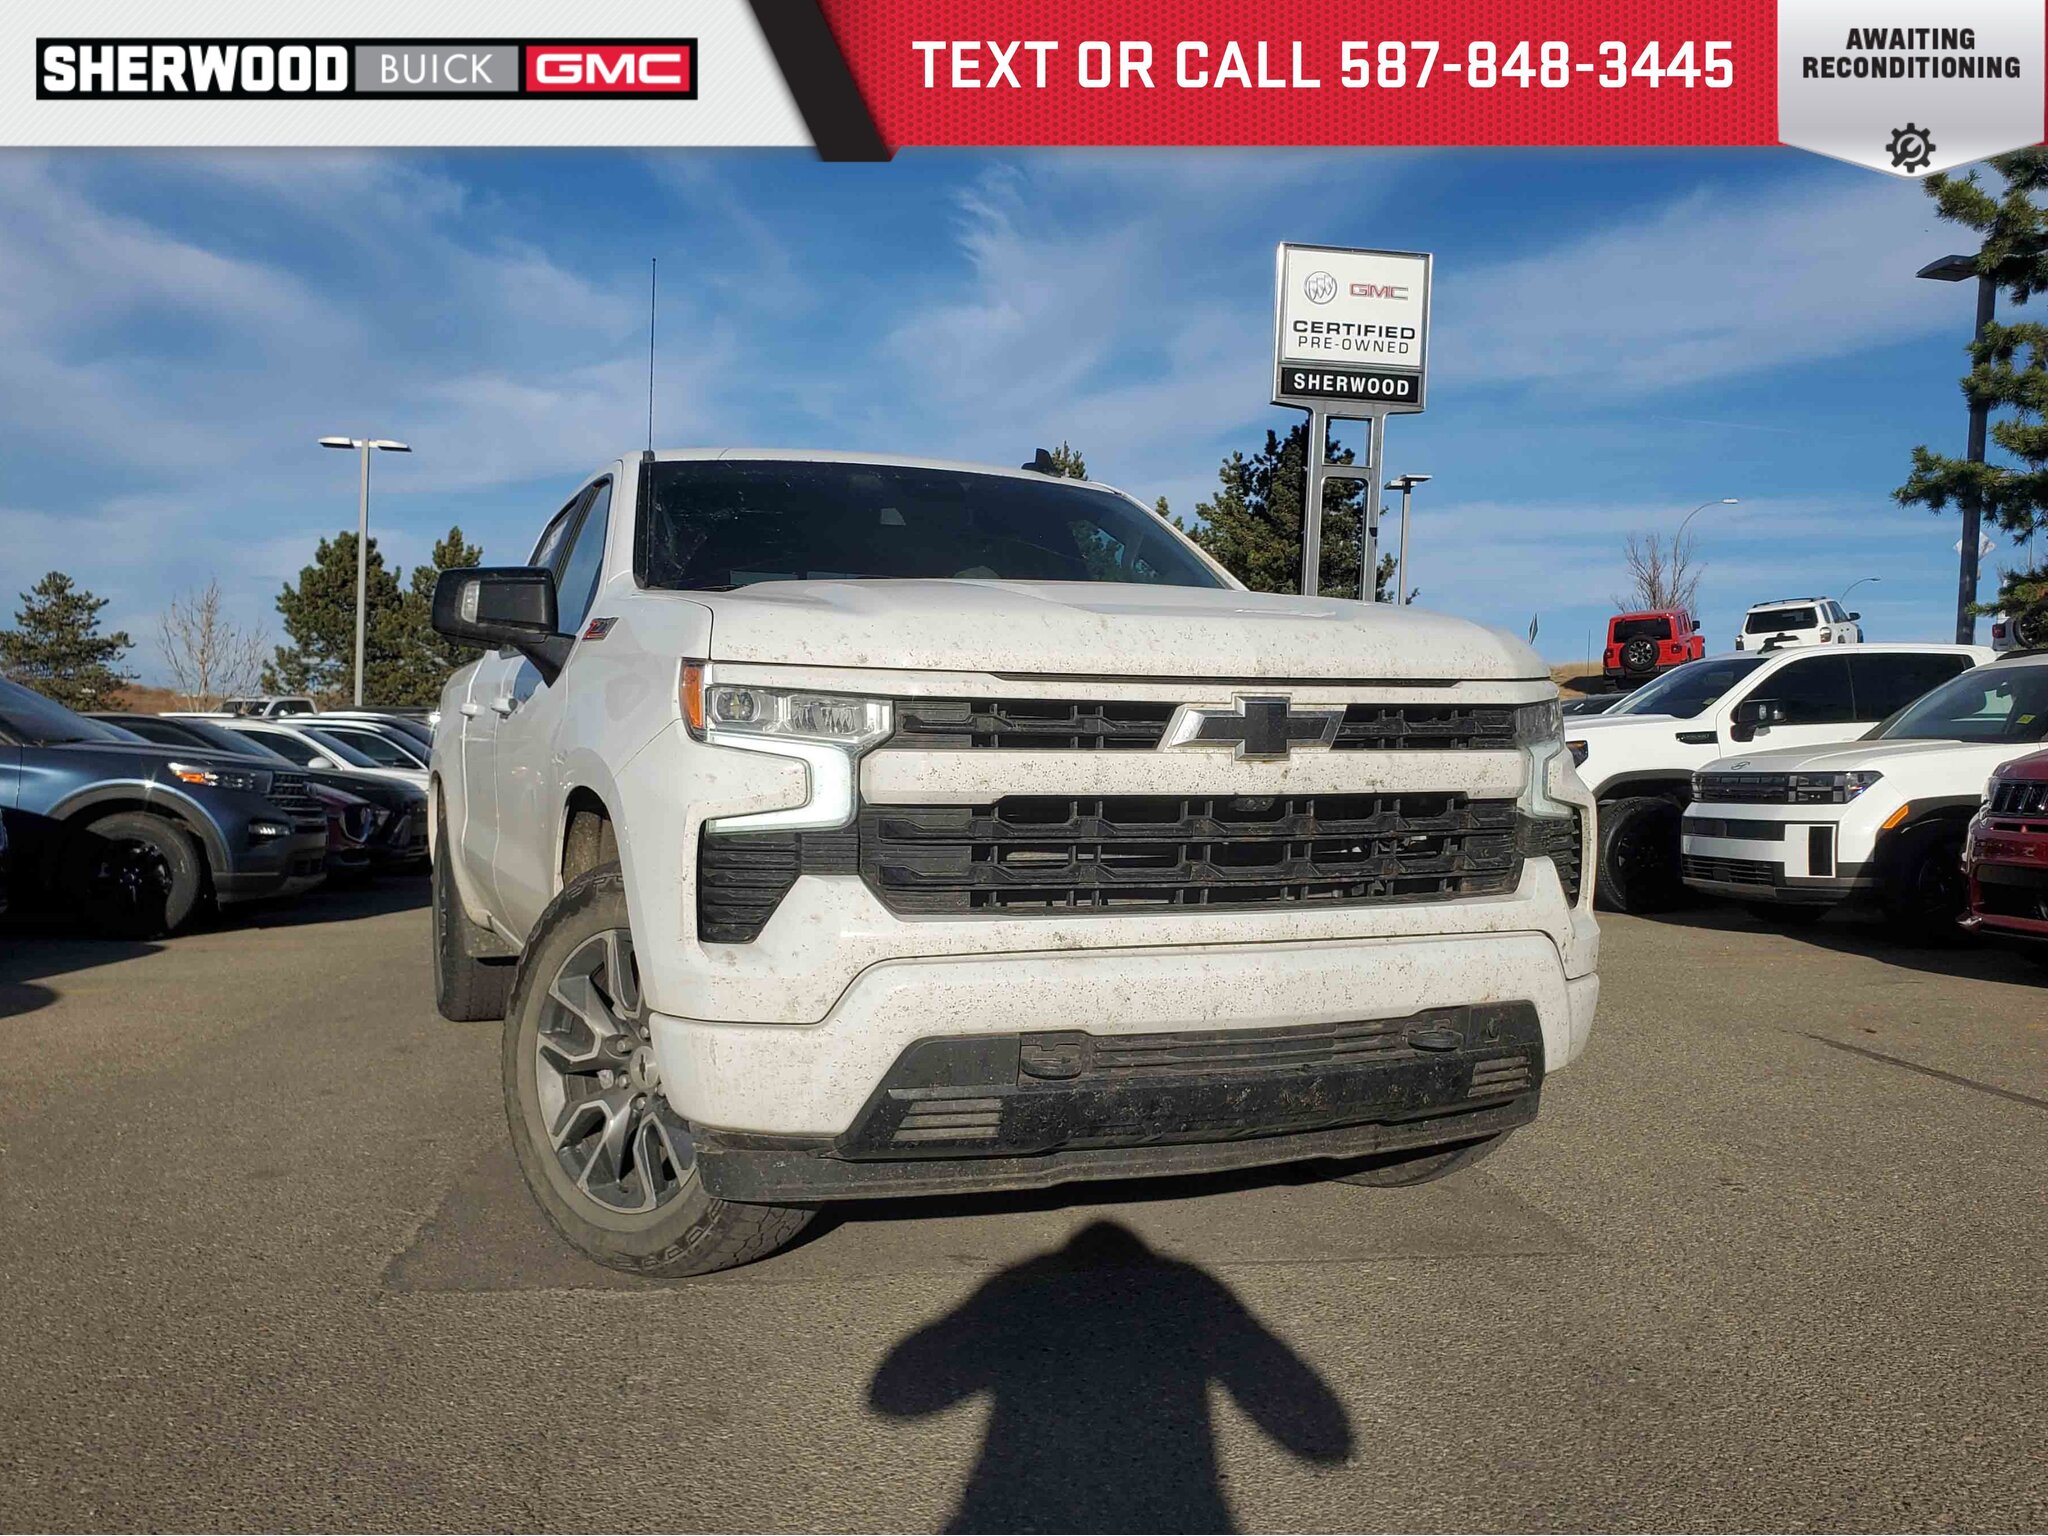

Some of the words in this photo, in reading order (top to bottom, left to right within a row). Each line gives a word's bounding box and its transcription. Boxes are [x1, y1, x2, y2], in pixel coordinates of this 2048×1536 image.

[1350, 283, 1409, 300] GMC
[1292, 320, 1416, 340] CERTIFIED
[1297, 335, 1409, 354] PRE-OWNED
[1293, 373, 1410, 396] SHERWOOD
